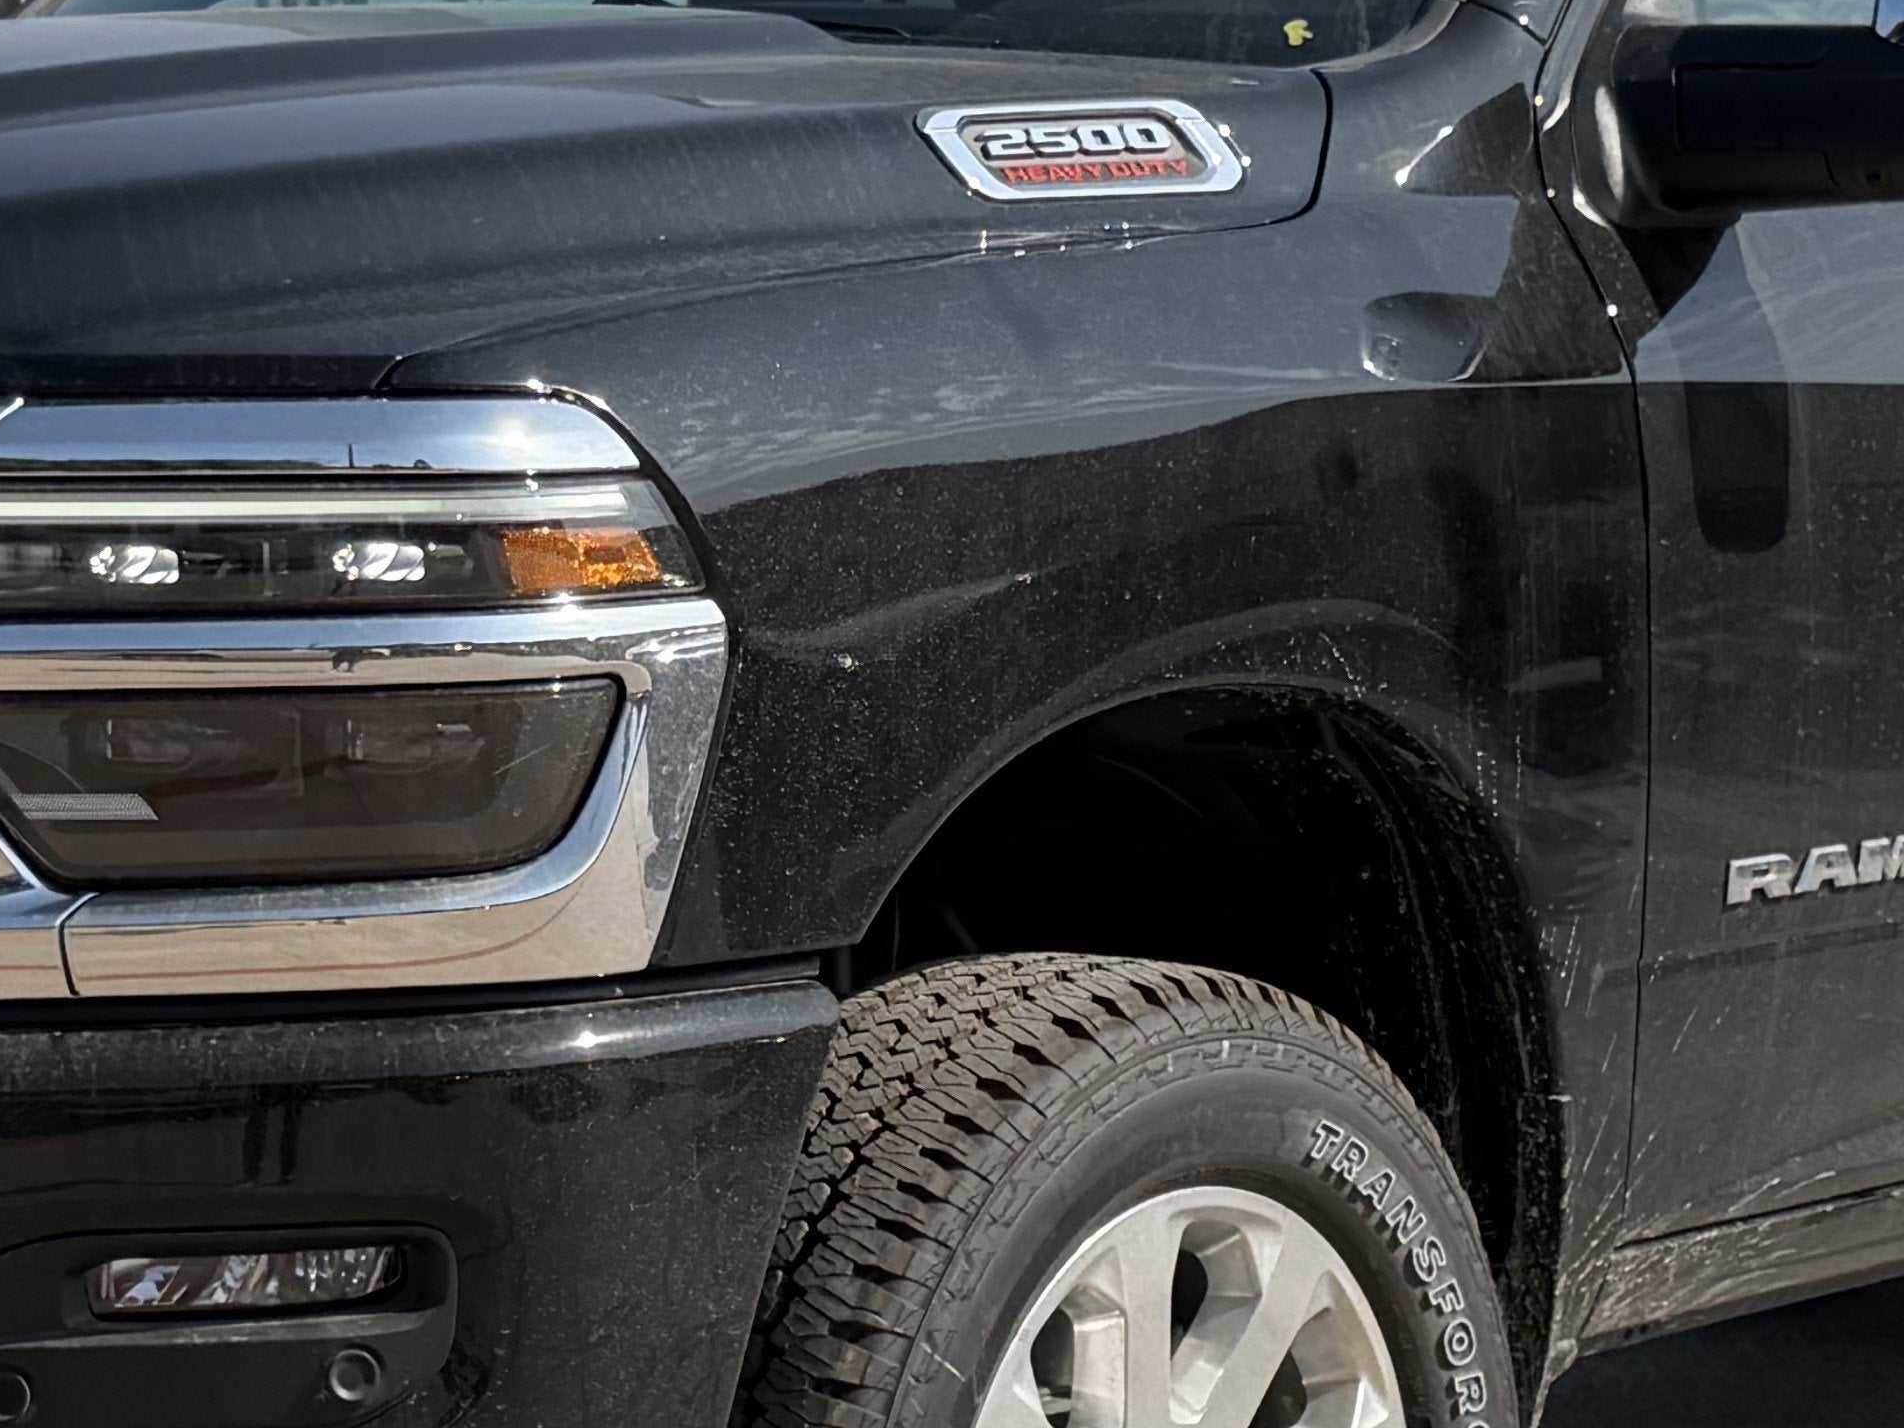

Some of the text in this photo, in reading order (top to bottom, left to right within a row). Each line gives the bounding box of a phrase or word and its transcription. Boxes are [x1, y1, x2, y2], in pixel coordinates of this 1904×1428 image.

[974, 121, 1172, 160] 2500
[1002, 158, 1188, 184] HEAVY DUTY
